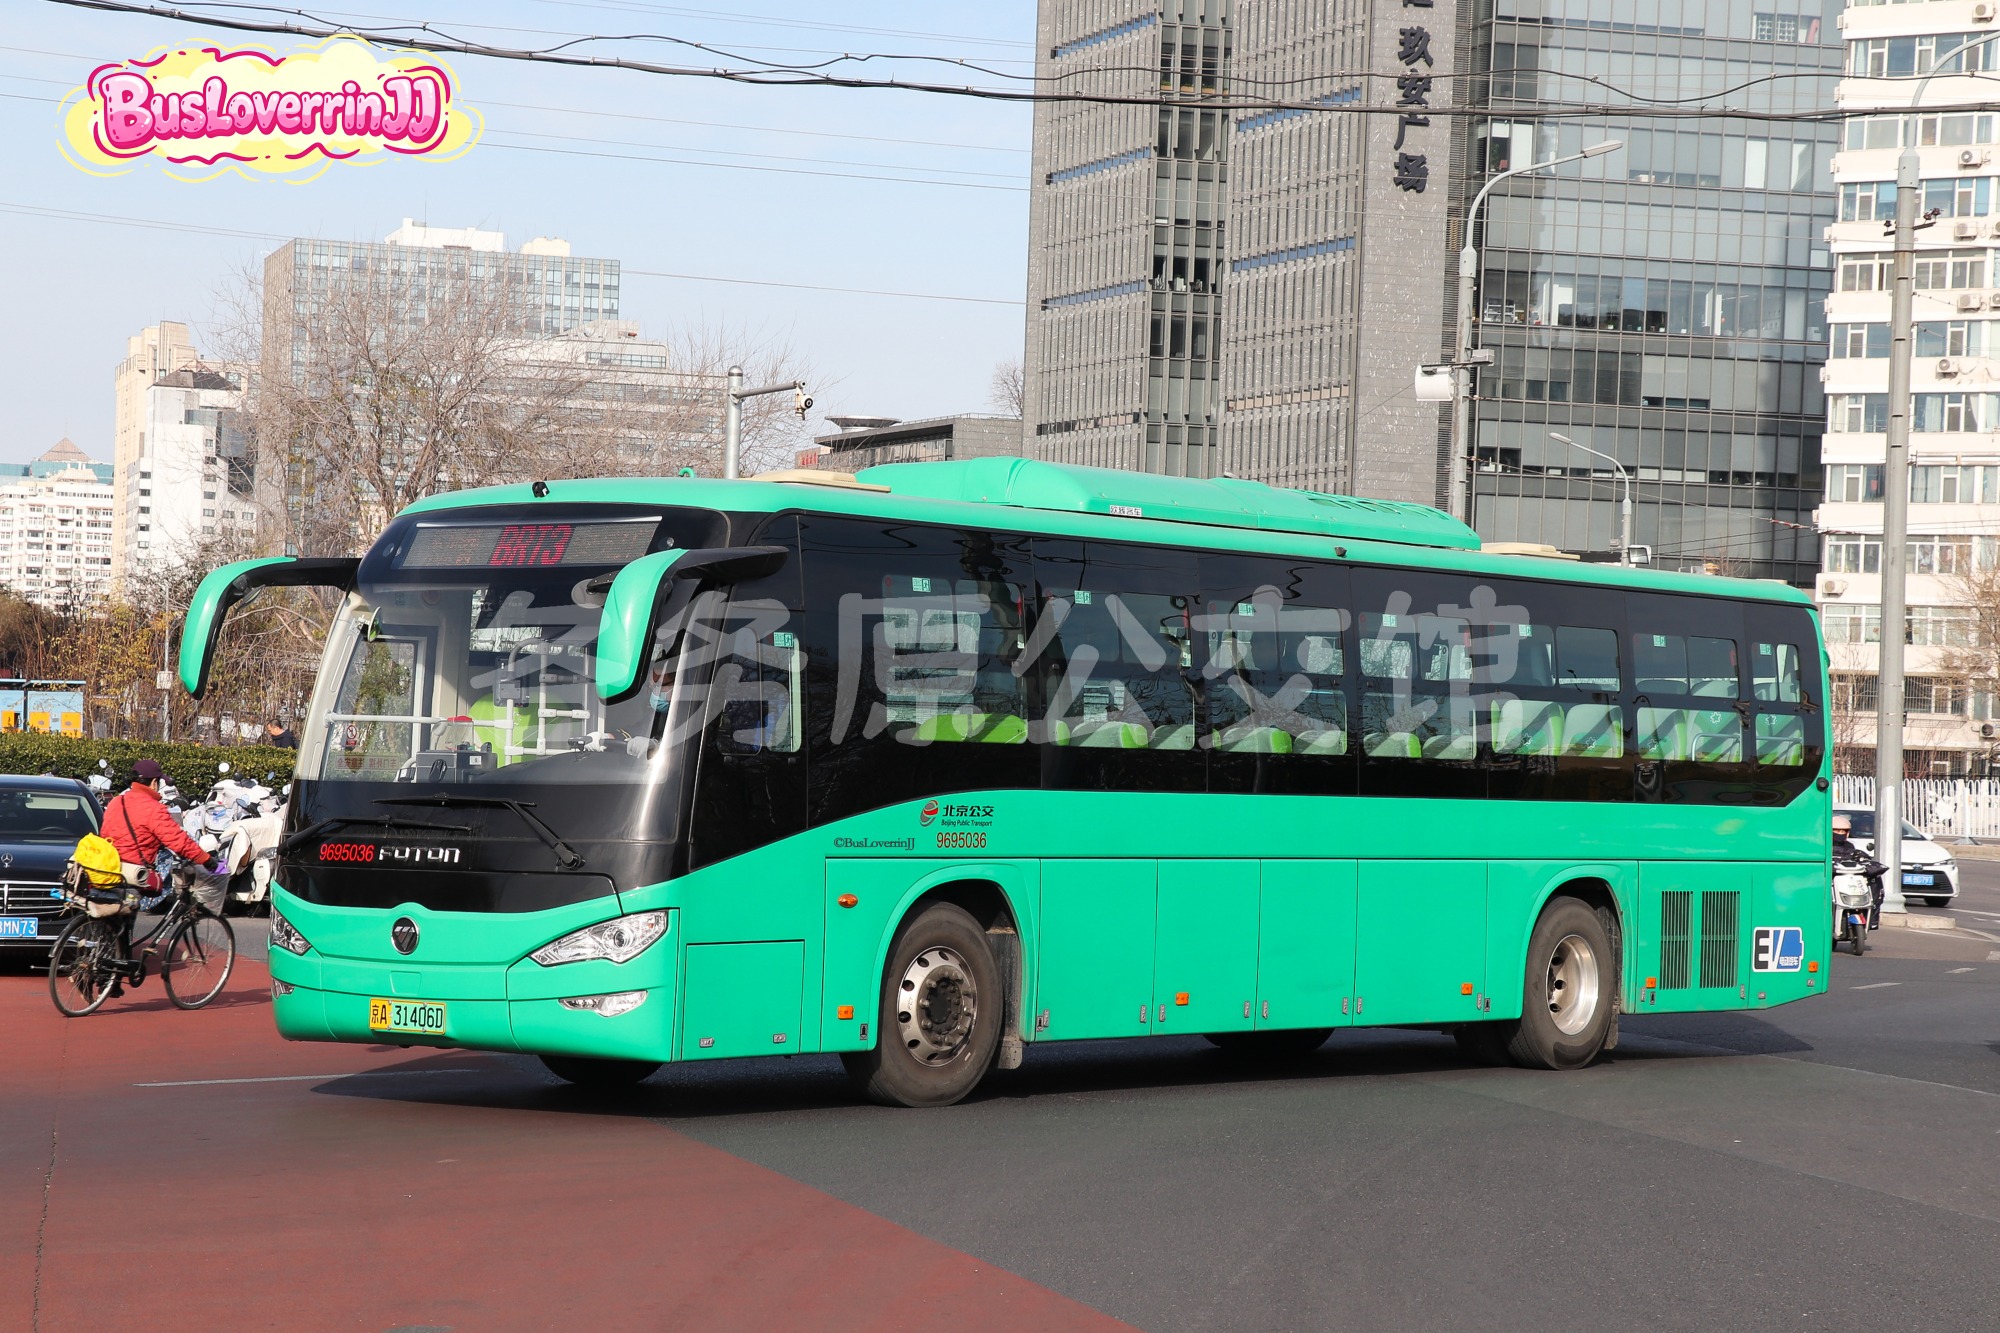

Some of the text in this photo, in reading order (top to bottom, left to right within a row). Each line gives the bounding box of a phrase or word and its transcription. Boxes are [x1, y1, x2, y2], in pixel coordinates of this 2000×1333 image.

[1394, 0, 1434, 194] 玖安广场
[488, 525, 573, 565] BRT3
[943, 805, 994, 817] 北京公交
[941, 819, 956, 828] Beijing
[936, 832, 987, 848] 9695036
[319, 843, 375, 862] 9695036
[378, 845, 461, 863] FOTON
